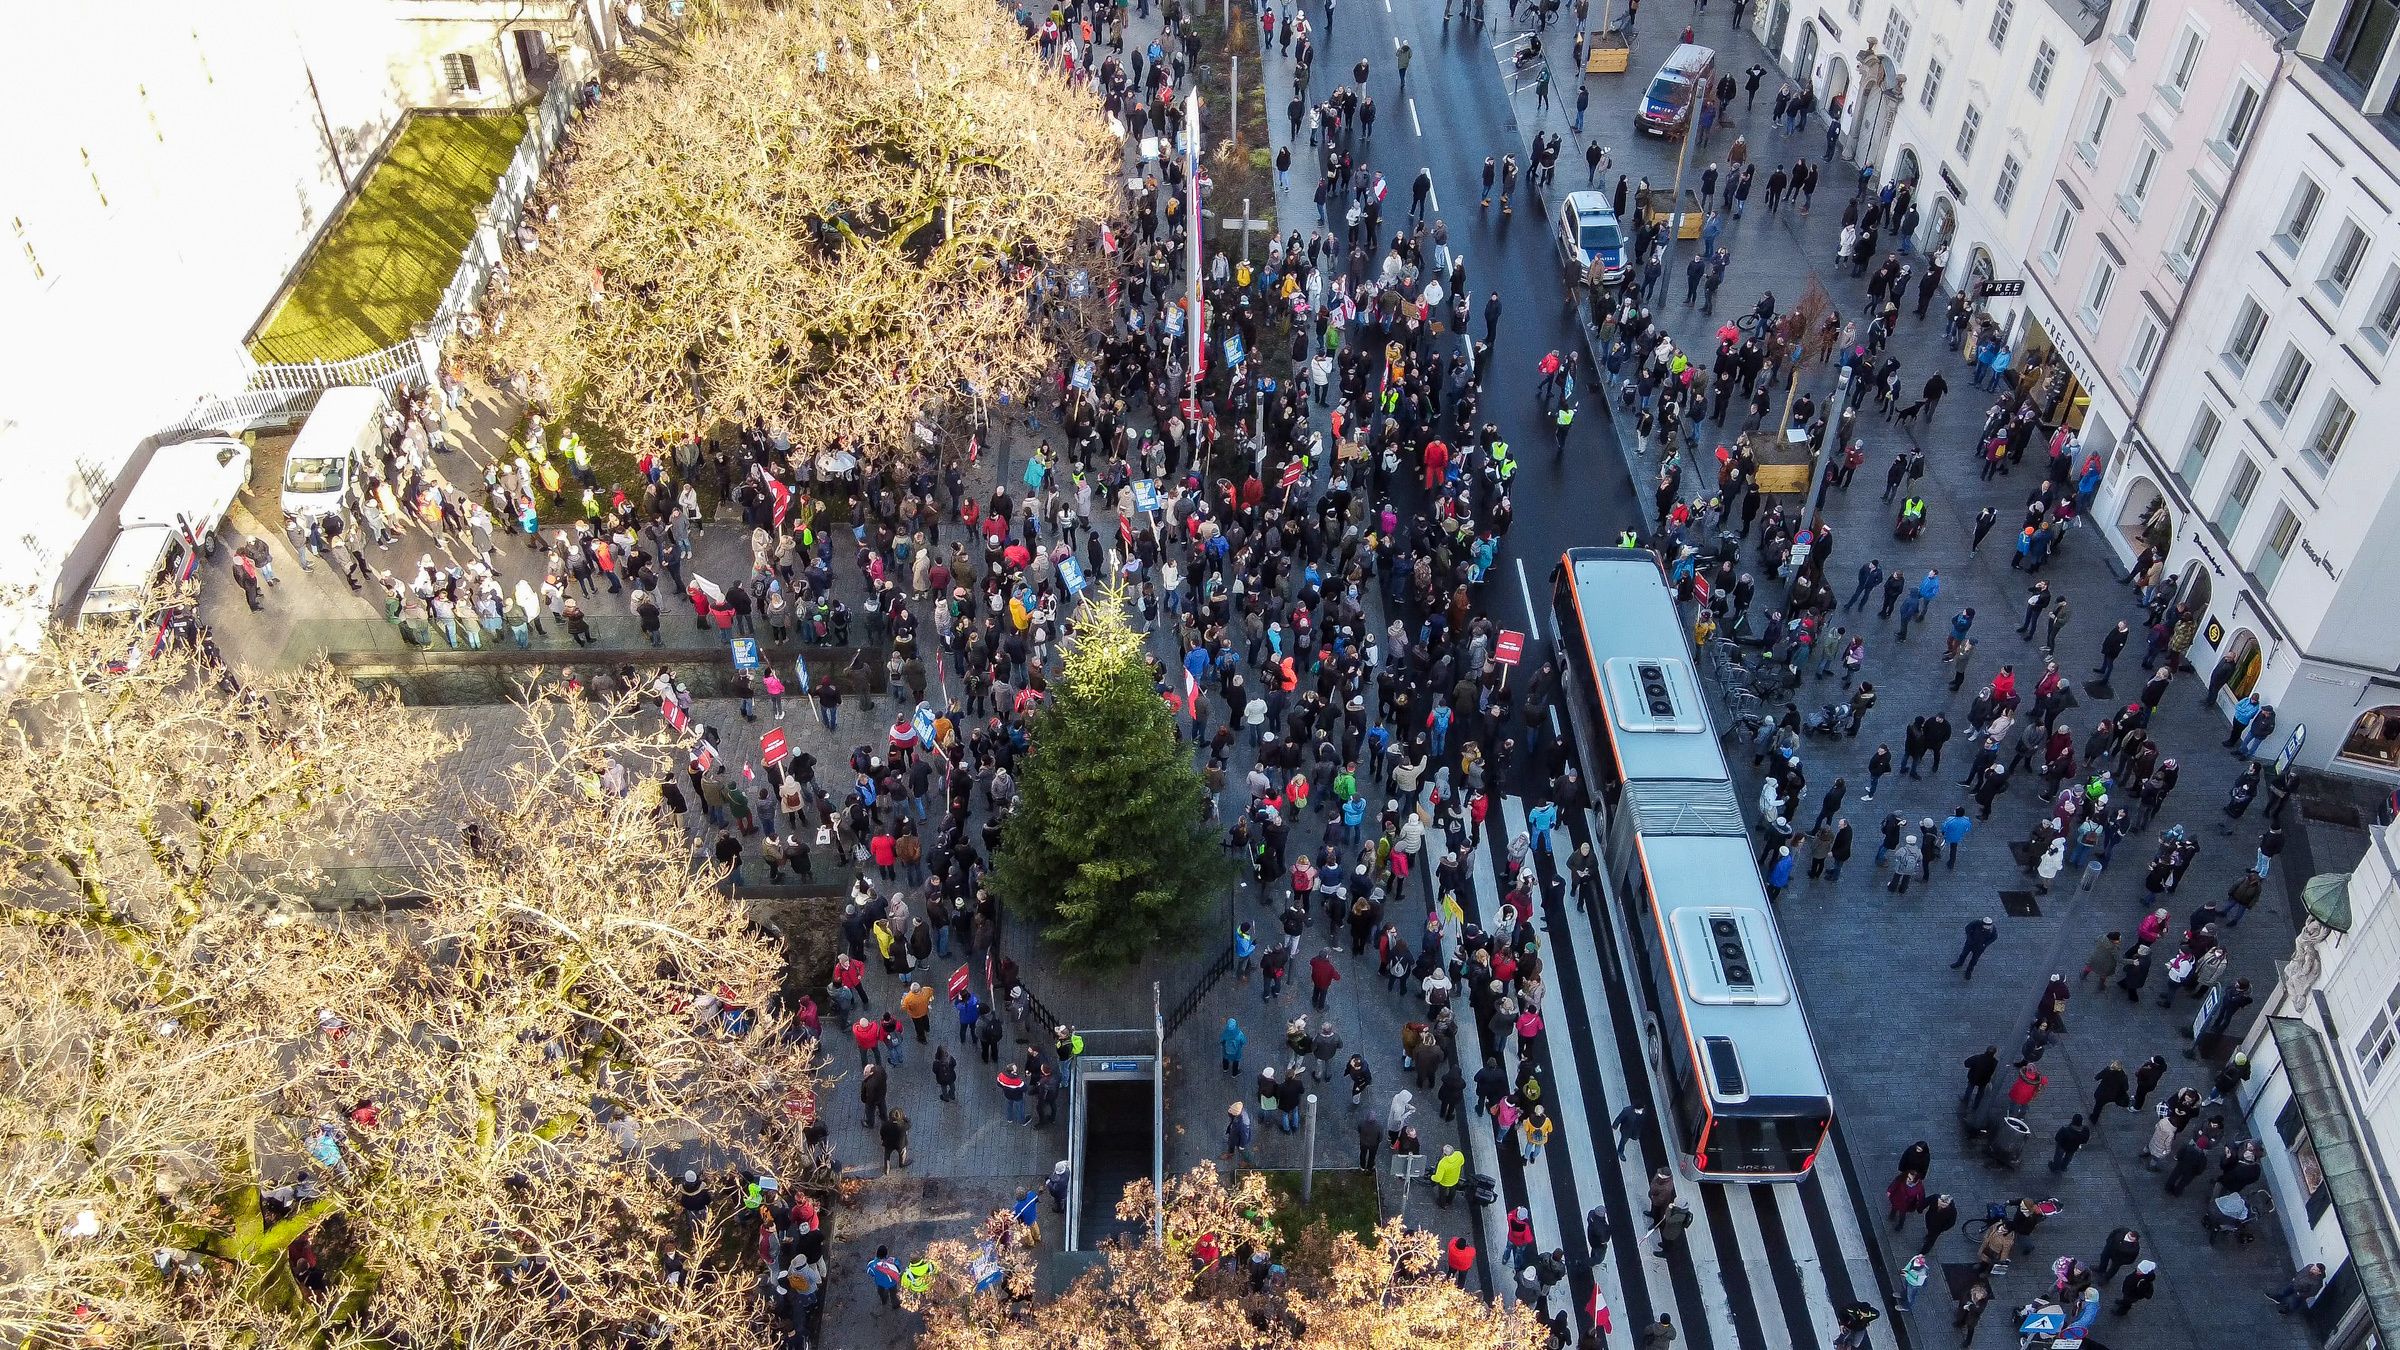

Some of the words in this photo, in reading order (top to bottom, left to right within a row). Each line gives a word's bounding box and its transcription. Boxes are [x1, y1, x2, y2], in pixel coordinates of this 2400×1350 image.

[1985, 282, 2021, 292] PREE
[2044, 316, 2068, 353] PREE
[2067, 350, 2097, 396] OPTIK
